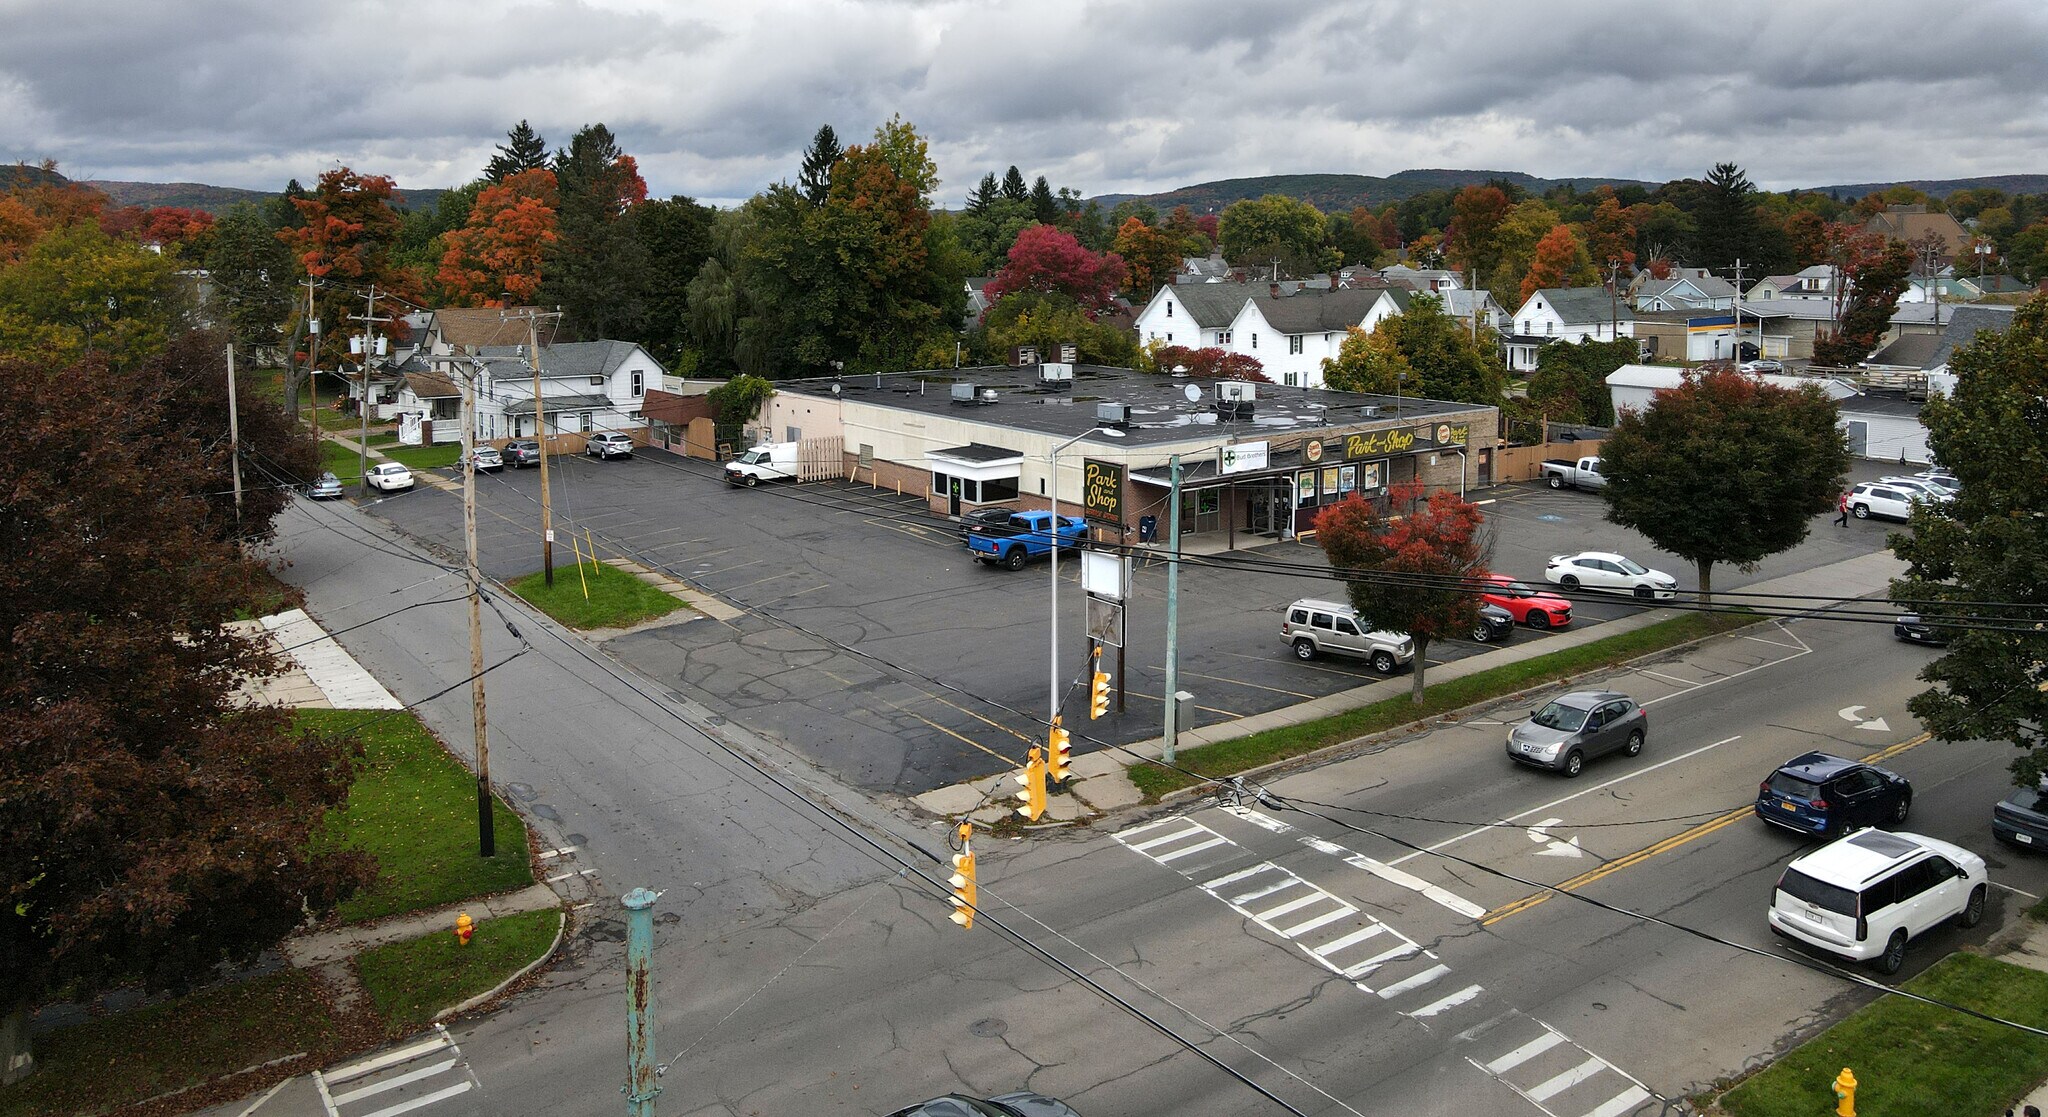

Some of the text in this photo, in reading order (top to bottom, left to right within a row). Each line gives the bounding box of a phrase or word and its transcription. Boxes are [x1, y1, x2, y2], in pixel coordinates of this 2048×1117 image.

[1347, 434, 1377, 458] Park
[1385, 430, 1414, 453] Shop
[1086, 463, 1118, 489] Park
[1087, 484, 1117, 513] Shop
